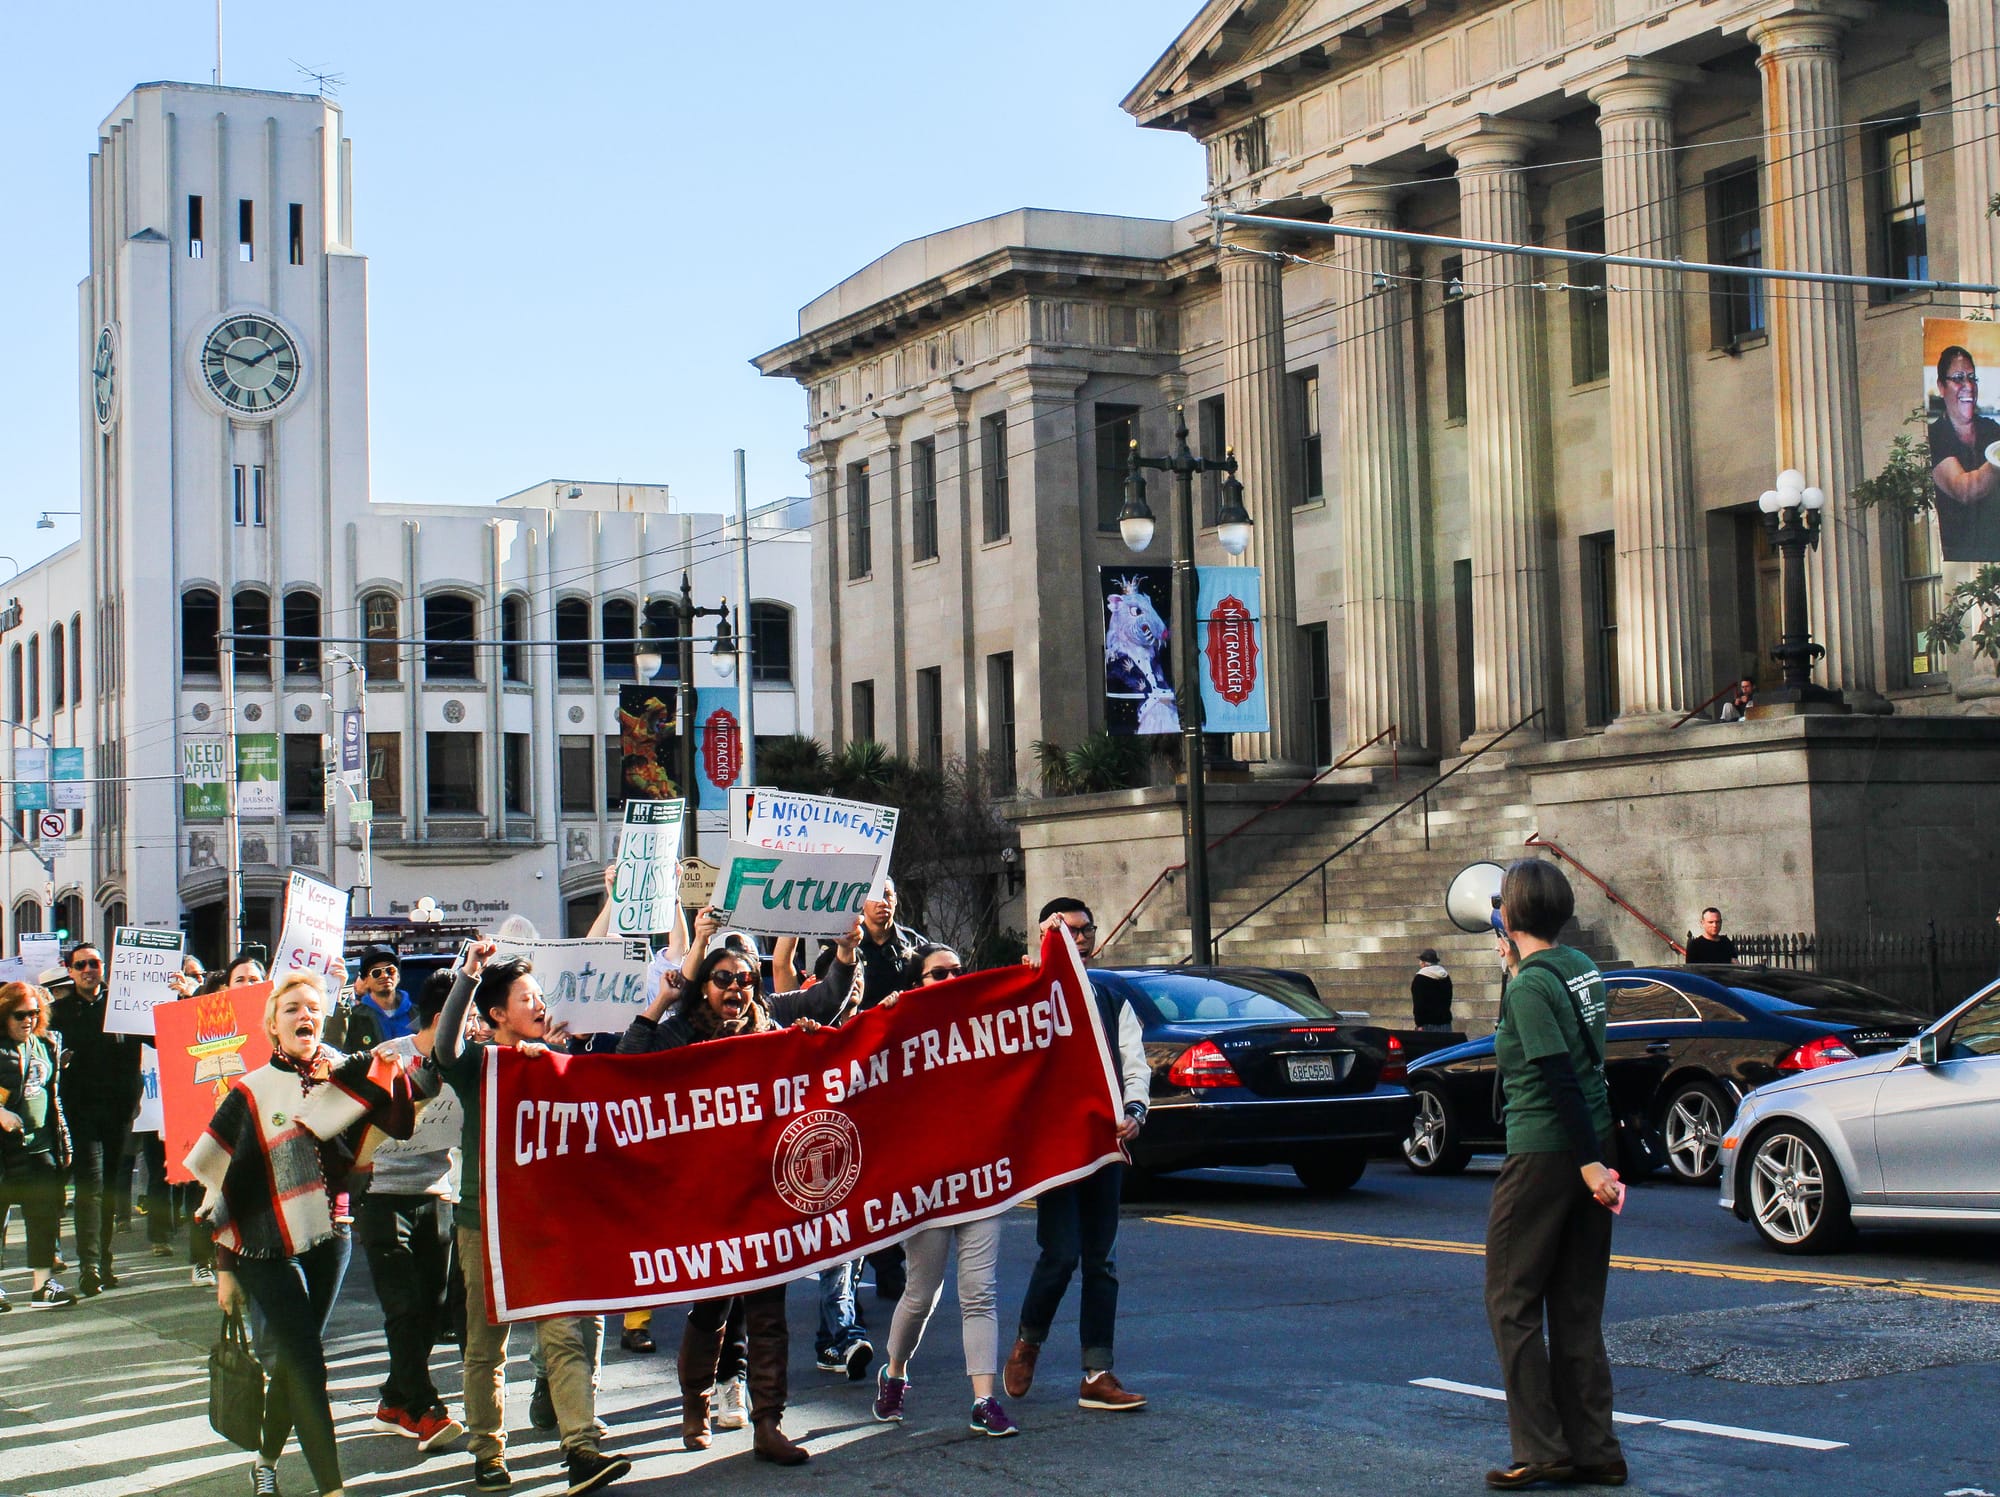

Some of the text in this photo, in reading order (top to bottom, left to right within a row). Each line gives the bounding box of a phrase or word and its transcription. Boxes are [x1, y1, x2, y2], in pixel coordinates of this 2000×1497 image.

[1222, 608, 1245, 693] NUTCRACKER
[184, 744, 224, 763] NEED
[715, 717, 729, 781] NUTCRACKER
[185, 763, 223, 779] APPLY
[633, 803, 652, 816] AFT
[881, 809, 896, 832] AFT
[757, 800, 889, 845] ENROLLMENT
[777, 824, 809, 838] IS A
[623, 831, 674, 860] KEEP
[292, 874, 306, 889] AFT
[684, 872, 701, 881] OLD
[723, 857, 872, 913] Future
[308, 884, 336, 913] Keep
[390, 900, 410, 915] San
[462, 899, 510, 914] Chronicle
[618, 901, 672, 931] OPEN
[311, 933, 322, 948] in
[115, 951, 165, 966] SPEND
[632, 941, 647, 963] AFT
[114, 970, 137, 982] THE
[119, 985, 131, 997] IN
[515, 1100, 599, 1166] CITY
[605, 1083, 763, 1148] COLLEGE
[774, 1074, 810, 1117] OF
[823, 1049, 889, 1103] SAN
[783, 1112, 853, 1143] CITY COLLEGE
[777, 1163, 858, 1212] OF SAN FRANCISCO
[630, 1157, 1012, 1287] DOWNTOWN CAMPUS
